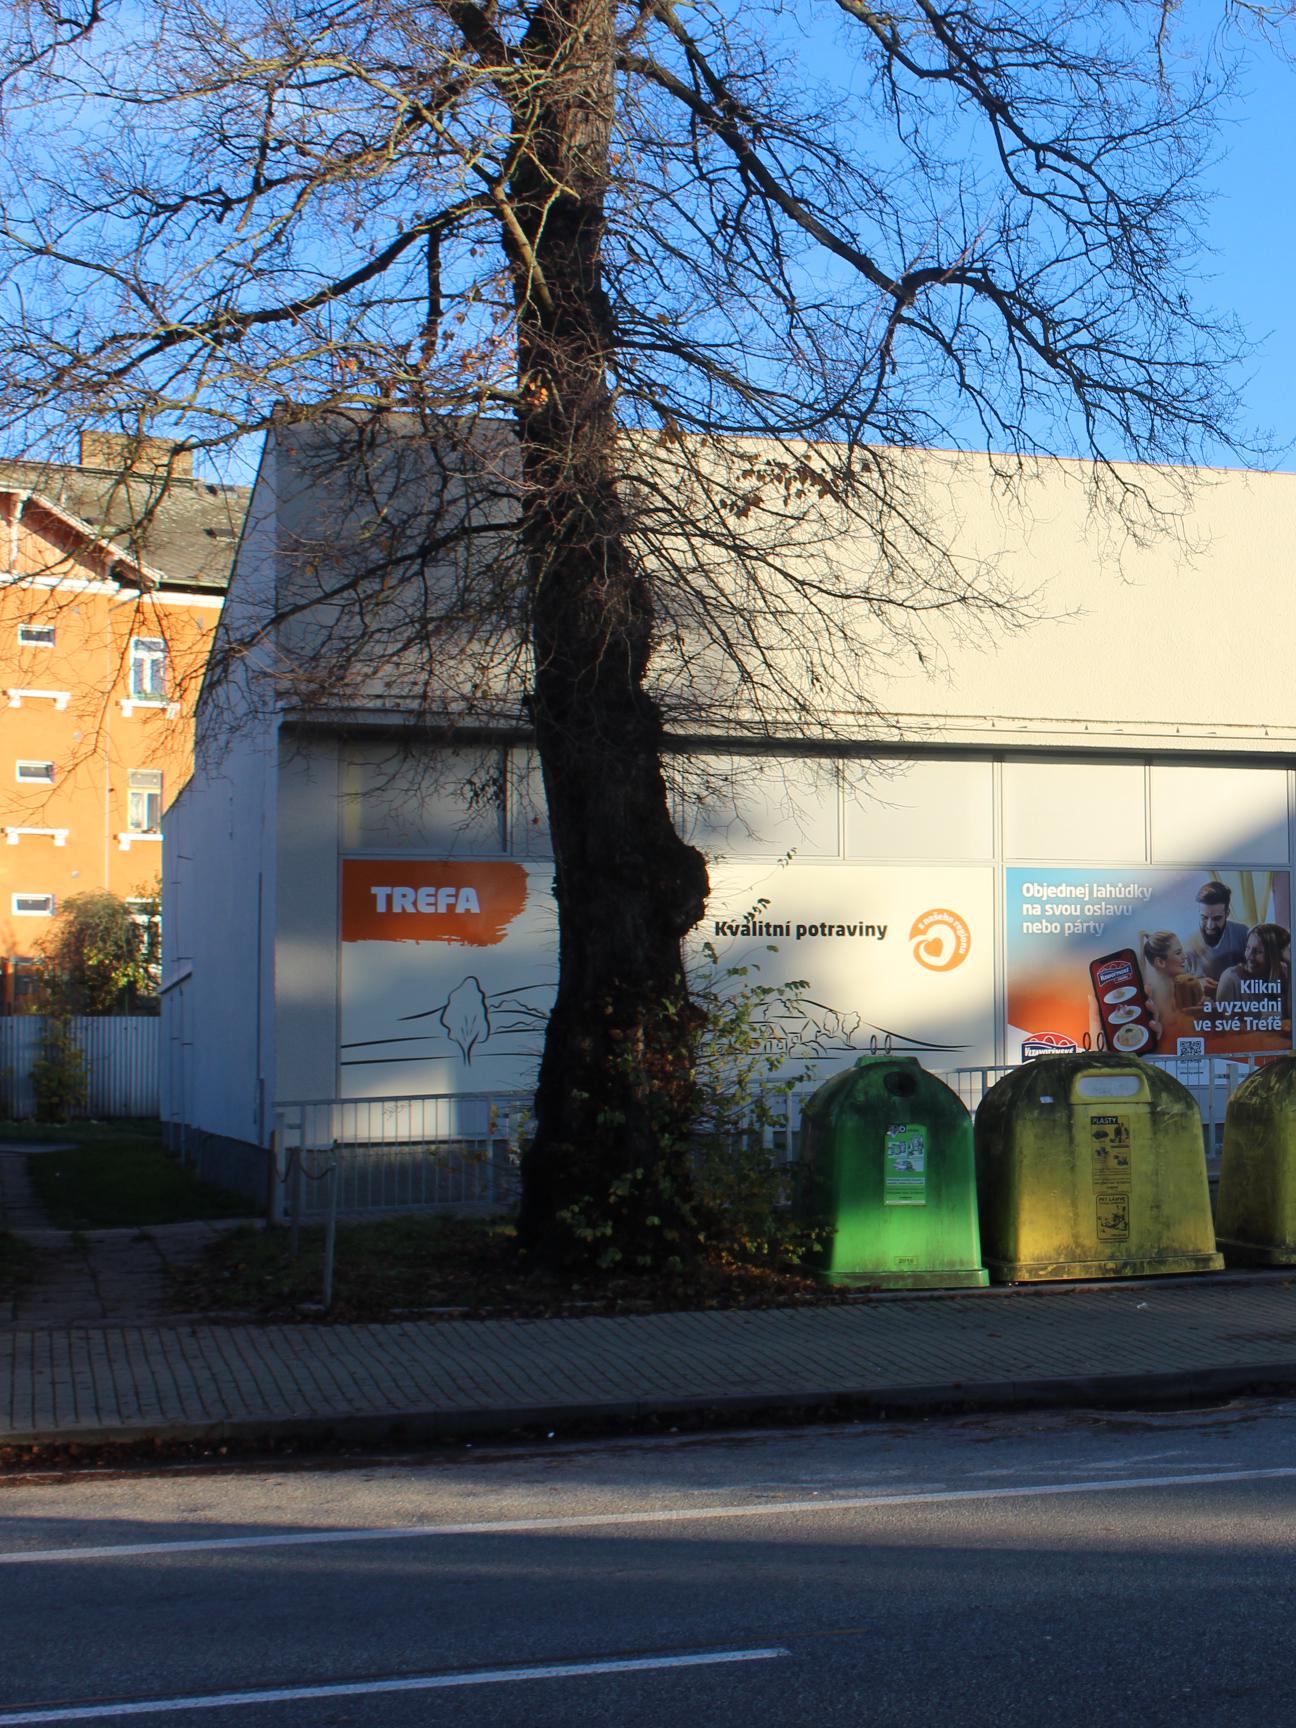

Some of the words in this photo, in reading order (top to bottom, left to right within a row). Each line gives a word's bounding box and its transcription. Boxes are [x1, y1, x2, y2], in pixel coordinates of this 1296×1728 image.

[370, 886, 481, 913] TREFA
[1022, 882, 1089, 901] Objednej
[1093, 882, 1153, 901] lahůdky
[1022, 904, 1041, 915] na
[1045, 904, 1080, 915] svou
[1084, 902, 1133, 916] oslavu
[714, 920, 791, 936] Kvalitní
[796, 921, 888, 940] potraviny
[1023, 919, 1060, 933] nebo
[1064, 919, 1104, 937] párty
[1240, 979, 1281, 994] Klikni
[1203, 1001, 1212, 1013] a
[1216, 997, 1282, 1016] vyzvedni
[1193, 1019, 1212, 1031] ve
[1215, 1016, 1240, 1031] své
[1244, 1016, 1282, 1031] Trefě
